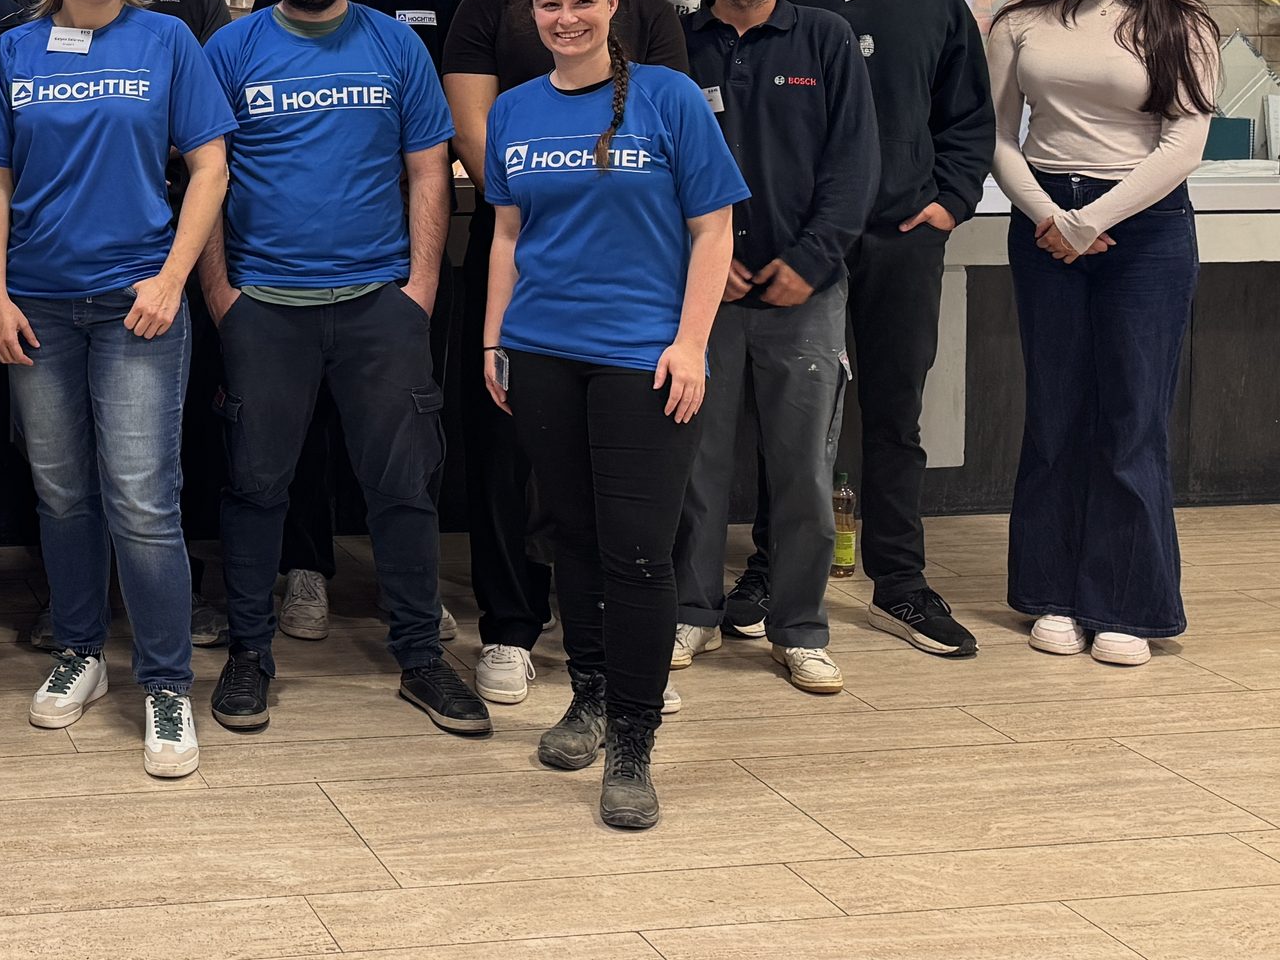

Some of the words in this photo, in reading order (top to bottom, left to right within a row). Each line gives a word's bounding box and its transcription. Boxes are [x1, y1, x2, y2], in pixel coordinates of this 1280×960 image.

[38, 79, 151, 100] HOCHTIEF
[788, 76, 817, 86] BOSCH
[281, 86, 392, 111] HOCHTIEF
